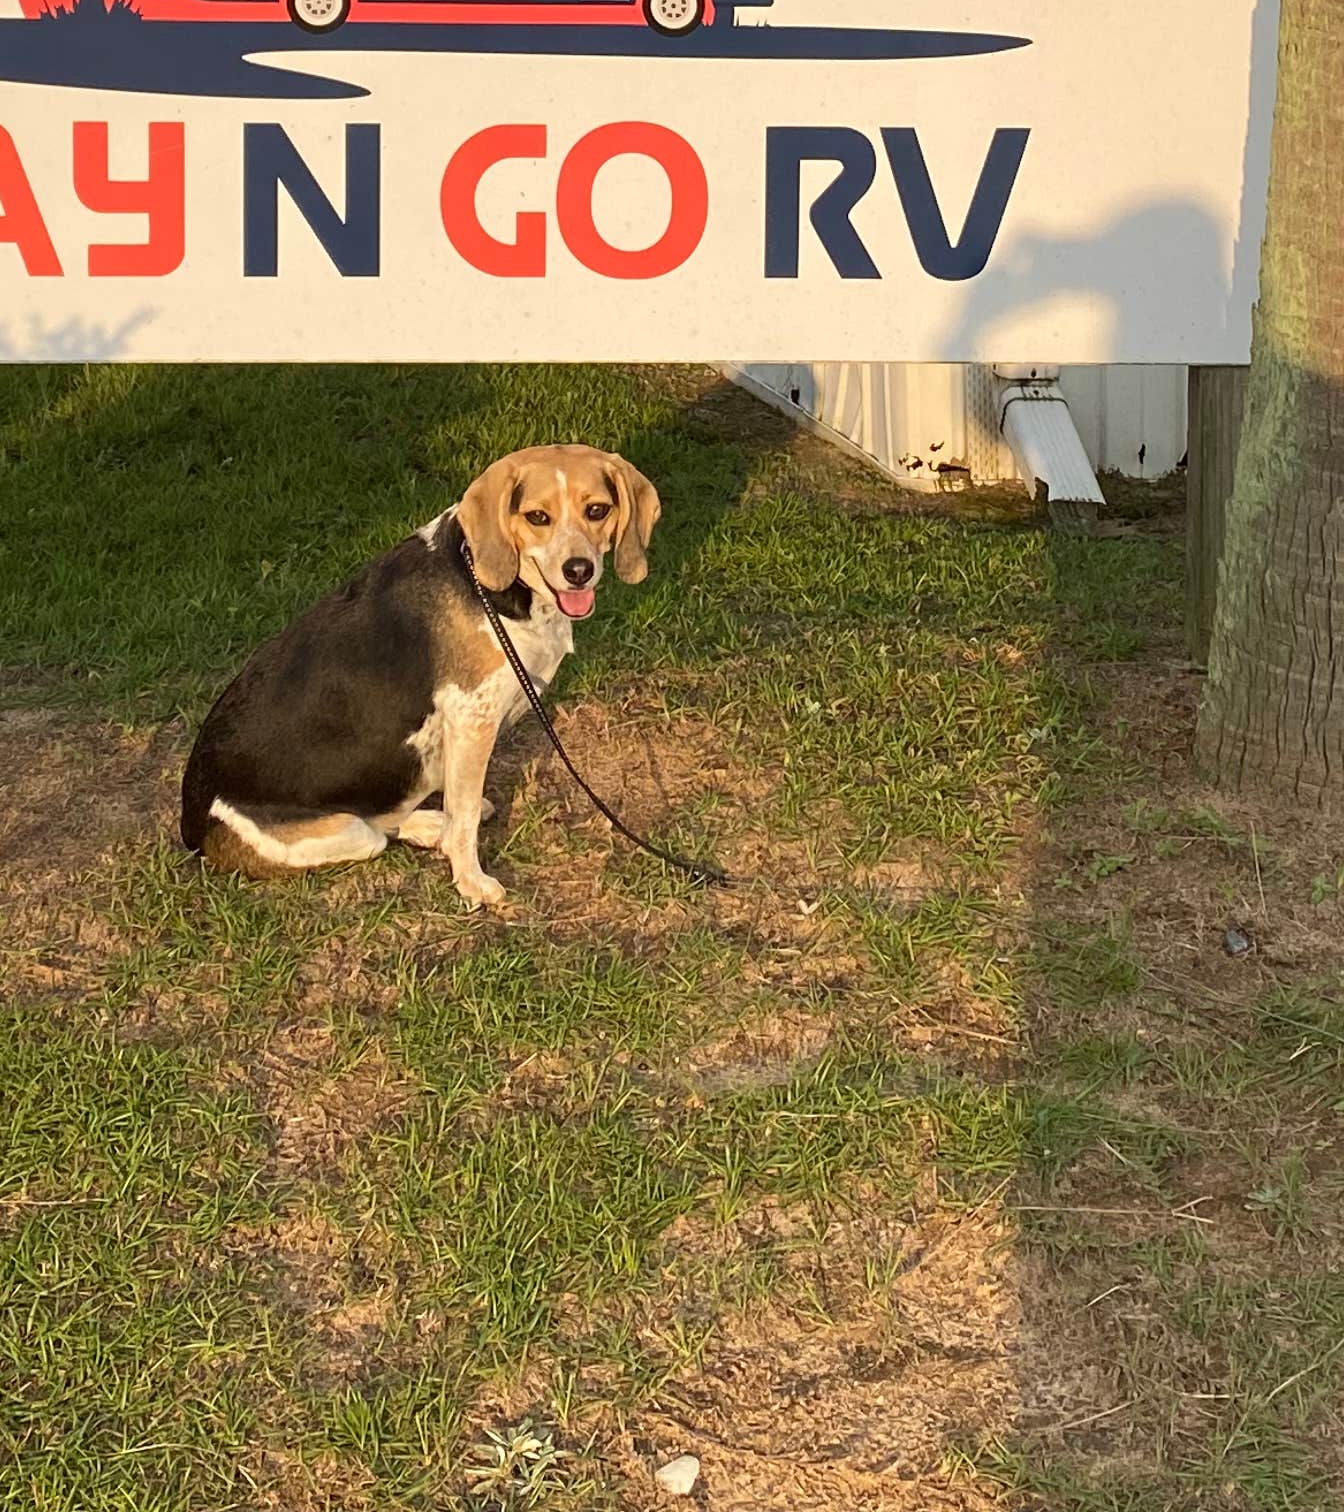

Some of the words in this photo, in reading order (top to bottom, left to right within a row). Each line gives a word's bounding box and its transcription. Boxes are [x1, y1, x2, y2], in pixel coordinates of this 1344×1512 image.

[243, 122, 381, 277] N
[439, 120, 709, 280] GO
[764, 126, 1031, 282] RV
